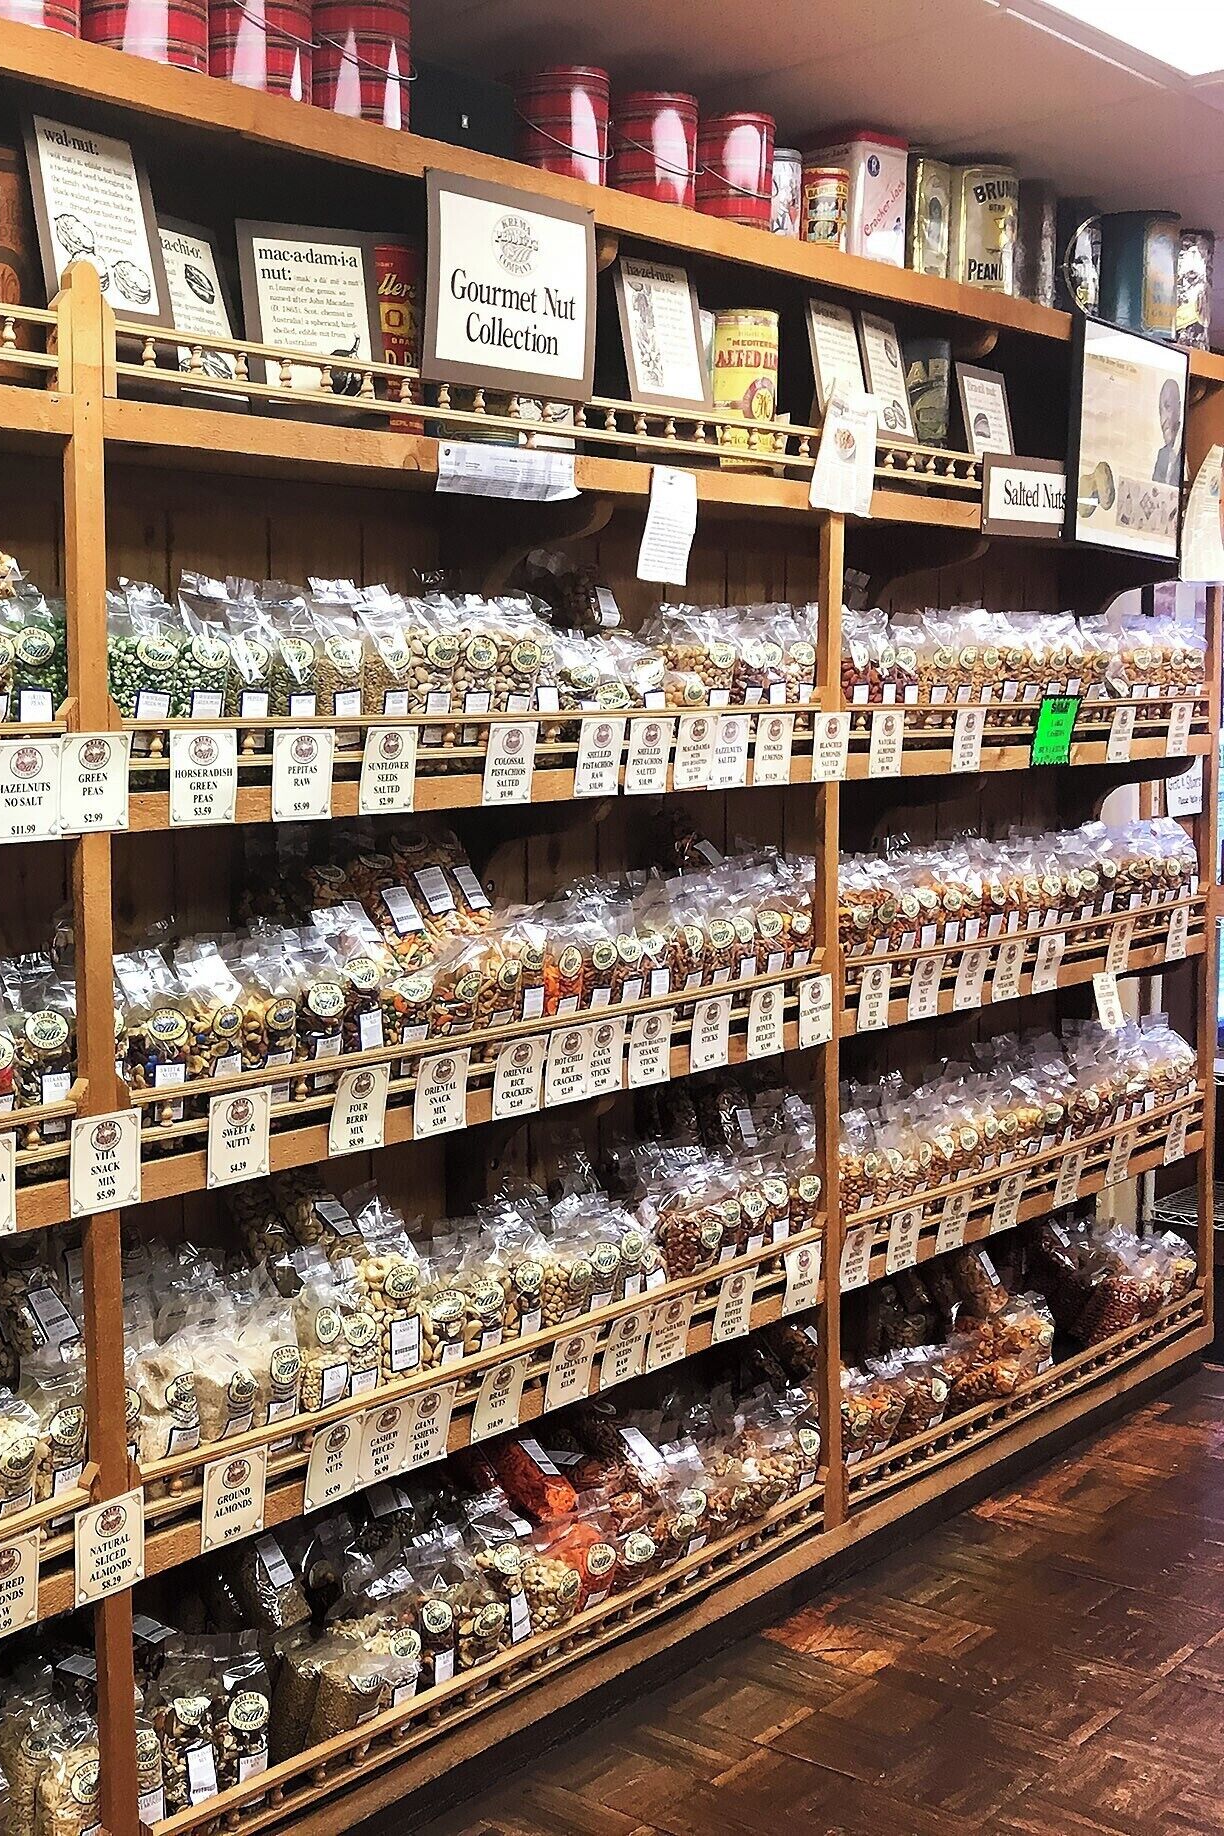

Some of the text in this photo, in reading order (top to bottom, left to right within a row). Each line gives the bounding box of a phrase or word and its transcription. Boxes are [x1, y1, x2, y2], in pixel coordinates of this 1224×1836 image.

[863, 199, 892, 237] Cracker
[260, 266, 292, 281] nut:
[450, 268, 576, 321] Gourmet Nut
[466, 311, 559, 356] Collection
[1004, 479, 1039, 508] Salted
[287, 764, 318, 775] PEPITAS
[368, 761, 409, 771] SUNFLOWER
[78, 772, 108, 783] GREEN
[174, 768, 233, 779] HORSERADISH
[377, 773, 398, 783] SEEDS
[189, 780, 218, 791] GREEN
[293, 777, 310, 787] RAW
[82, 785, 104, 796] PEAS
[373, 784, 400, 795] SALTED
[4, 796, 43, 808] NO SALT
[193, 793, 214, 804] PEAS
[193, 806, 212, 817] $3.59
[83, 813, 103, 824] $2.99
[10, 824, 36, 835] $11.99
[424, 1082, 458, 1096] ORIENTAL
[429, 1093, 452, 1106] SNACK
[348, 1102, 368, 1113] FOUR
[432, 1105, 447, 1116] MIX
[345, 1113, 370, 1125] BERRY
[221, 1124, 248, 1139] SWEET
[349, 1125, 364, 1135] MIX
[225, 1135, 251, 1149] NUTTY
[94, 1150, 117, 1162] VITA
[90, 1161, 120, 1176] SNACK
[97, 1175, 116, 1187] MIX
[96, 1188, 116, 1201] $5.99
[370, 1429, 399, 1448] CASHEW
[326, 1450, 344, 1465] PINE
[374, 1454, 392, 1467] RAW
[325, 1460, 344, 1476] NUTS
[217, 1487, 251, 1506] GROUND
[213, 1498, 252, 1519] ALMONDS
[223, 1525, 241, 1538] $9.99
[89, 1533, 131, 1557] NATURAL
[94, 1547, 127, 1568] SLICED
[89, 1557, 132, 1583] ALMONDS
[101, 1575, 121, 1591] $8.29
